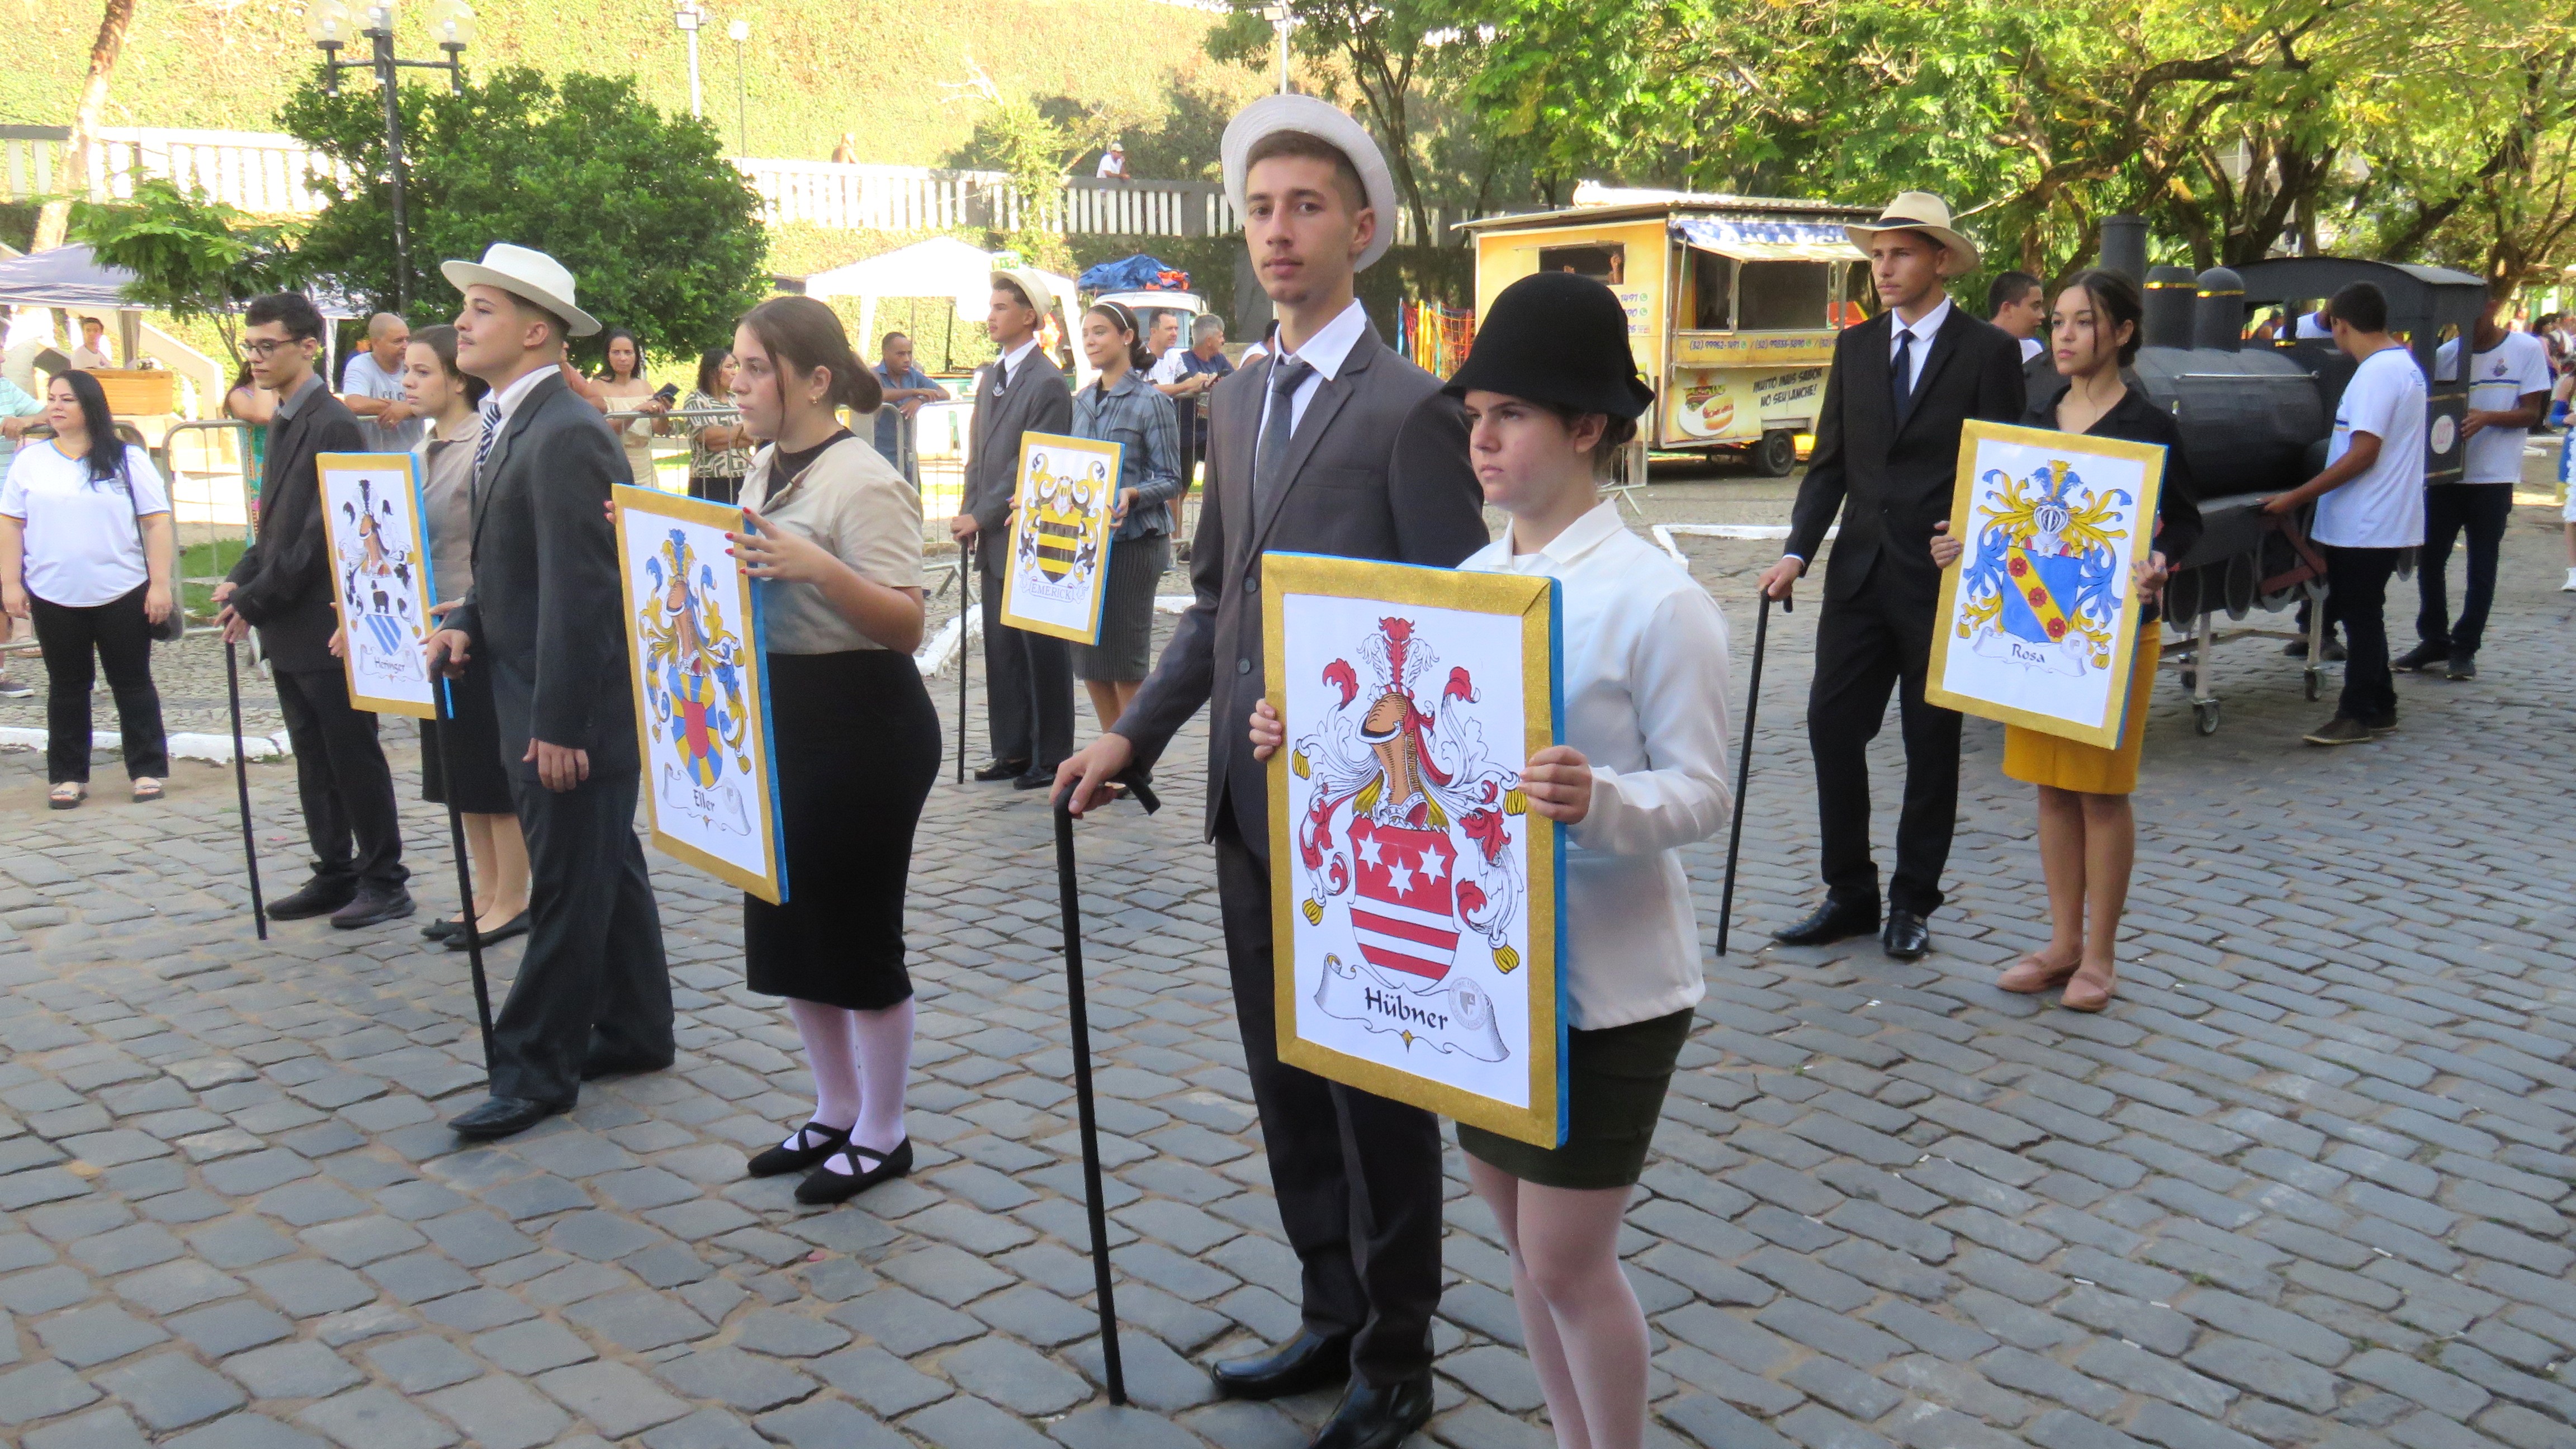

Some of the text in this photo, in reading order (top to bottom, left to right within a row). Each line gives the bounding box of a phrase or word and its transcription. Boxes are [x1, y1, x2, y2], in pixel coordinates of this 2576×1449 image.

[1753, 367, 1823, 394] MUITO MAIS SABOR
[1760, 383, 1817, 408] NO SEU LANCHE!
[1031, 583, 1071, 600] EMERICK
[2011, 643, 2045, 664] Rosa
[693, 789, 715, 812] Eller
[1365, 987, 1449, 1030] Hübner
